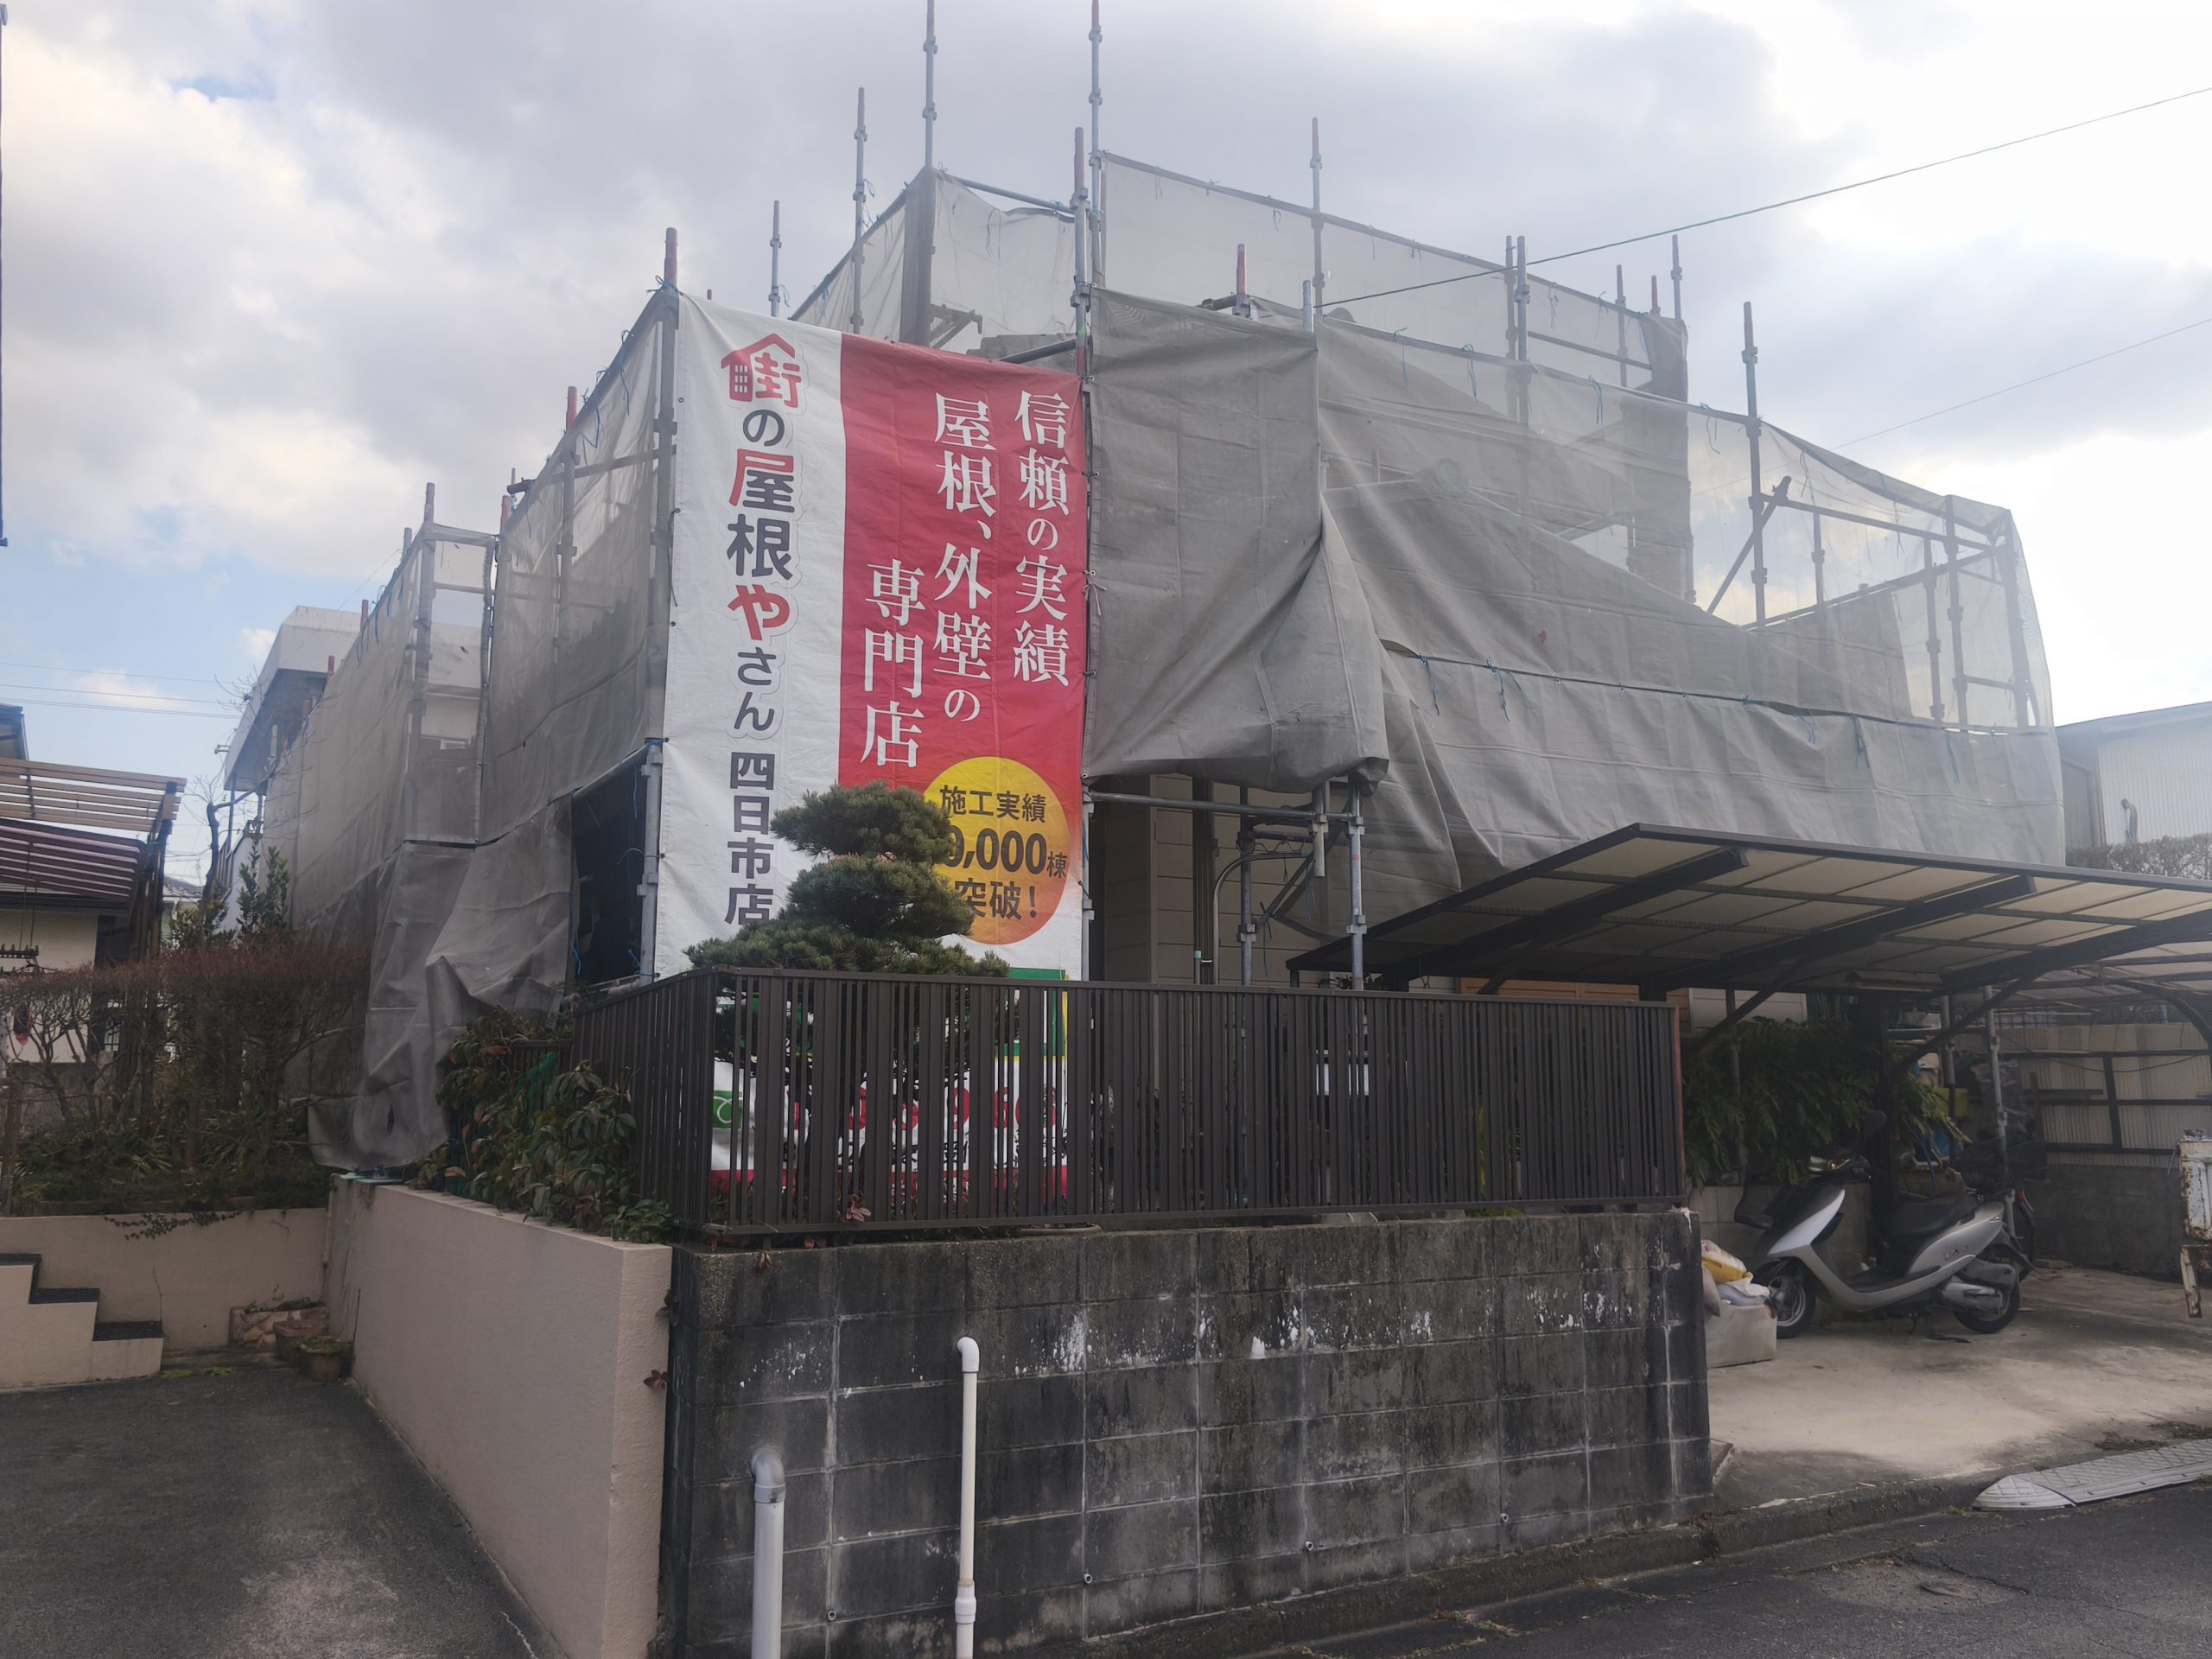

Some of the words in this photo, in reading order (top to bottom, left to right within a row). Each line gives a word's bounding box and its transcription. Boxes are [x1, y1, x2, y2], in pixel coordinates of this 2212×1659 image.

[860, 558, 925, 768] 専門店
[932, 392, 996, 722] 屋根、外壁の
[1014, 390, 1071, 687] 信頼の実績
[940, 785, 1046, 823] 施工実績
